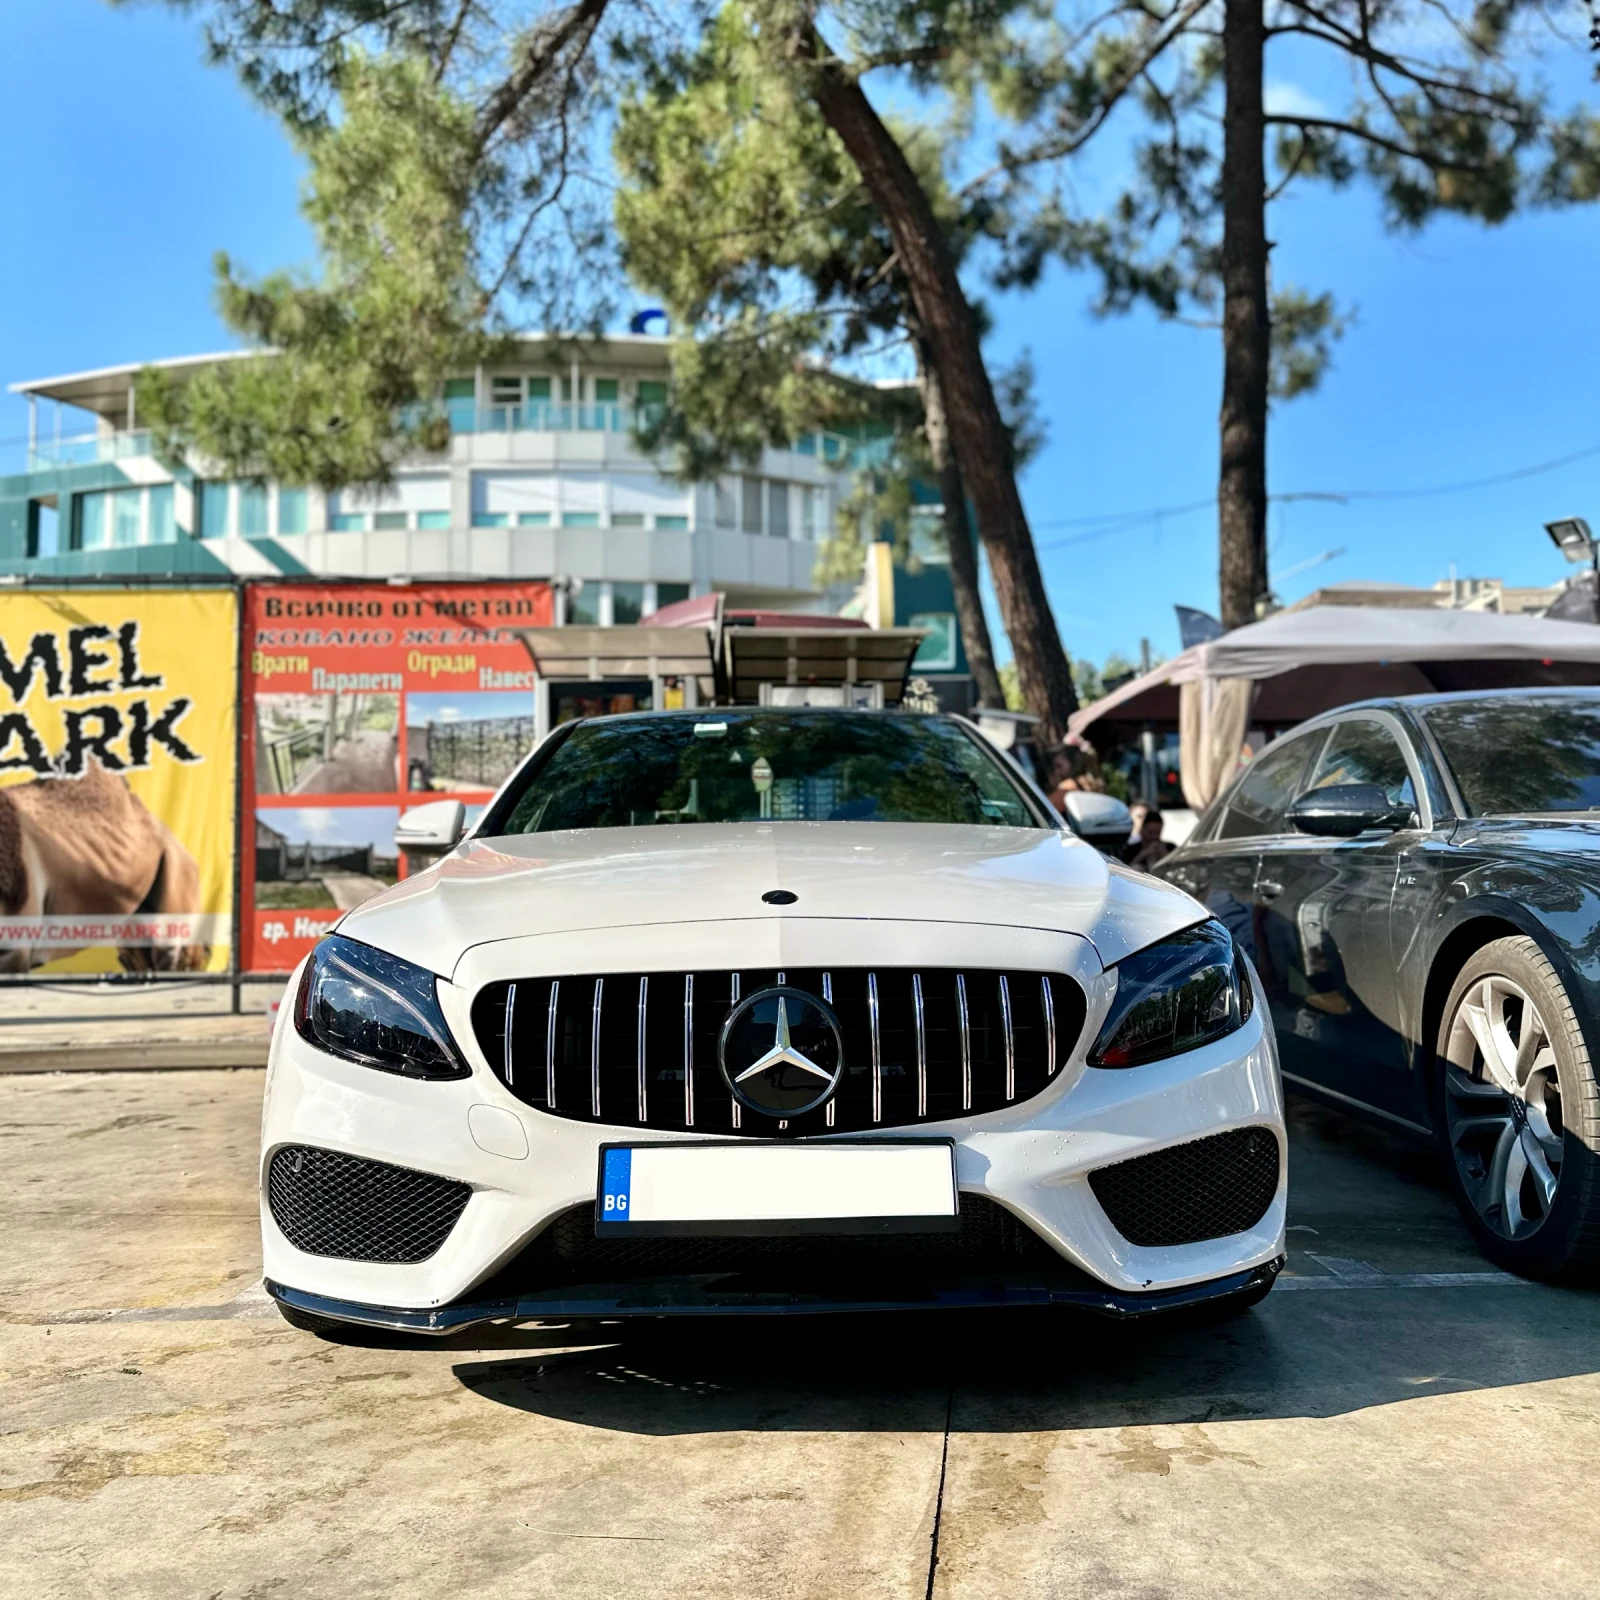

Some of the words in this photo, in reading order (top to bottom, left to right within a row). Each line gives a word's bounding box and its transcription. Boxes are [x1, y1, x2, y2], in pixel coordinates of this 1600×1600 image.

[265, 598, 382, 618] Всичко
[392, 600, 423, 617] от
[252, 650, 309, 680] Врати
[407, 649, 476, 679] Огради
[312, 667, 403, 695] Парапети
[479, 665, 539, 690] Навес
[604, 1194, 627, 1211] BG
